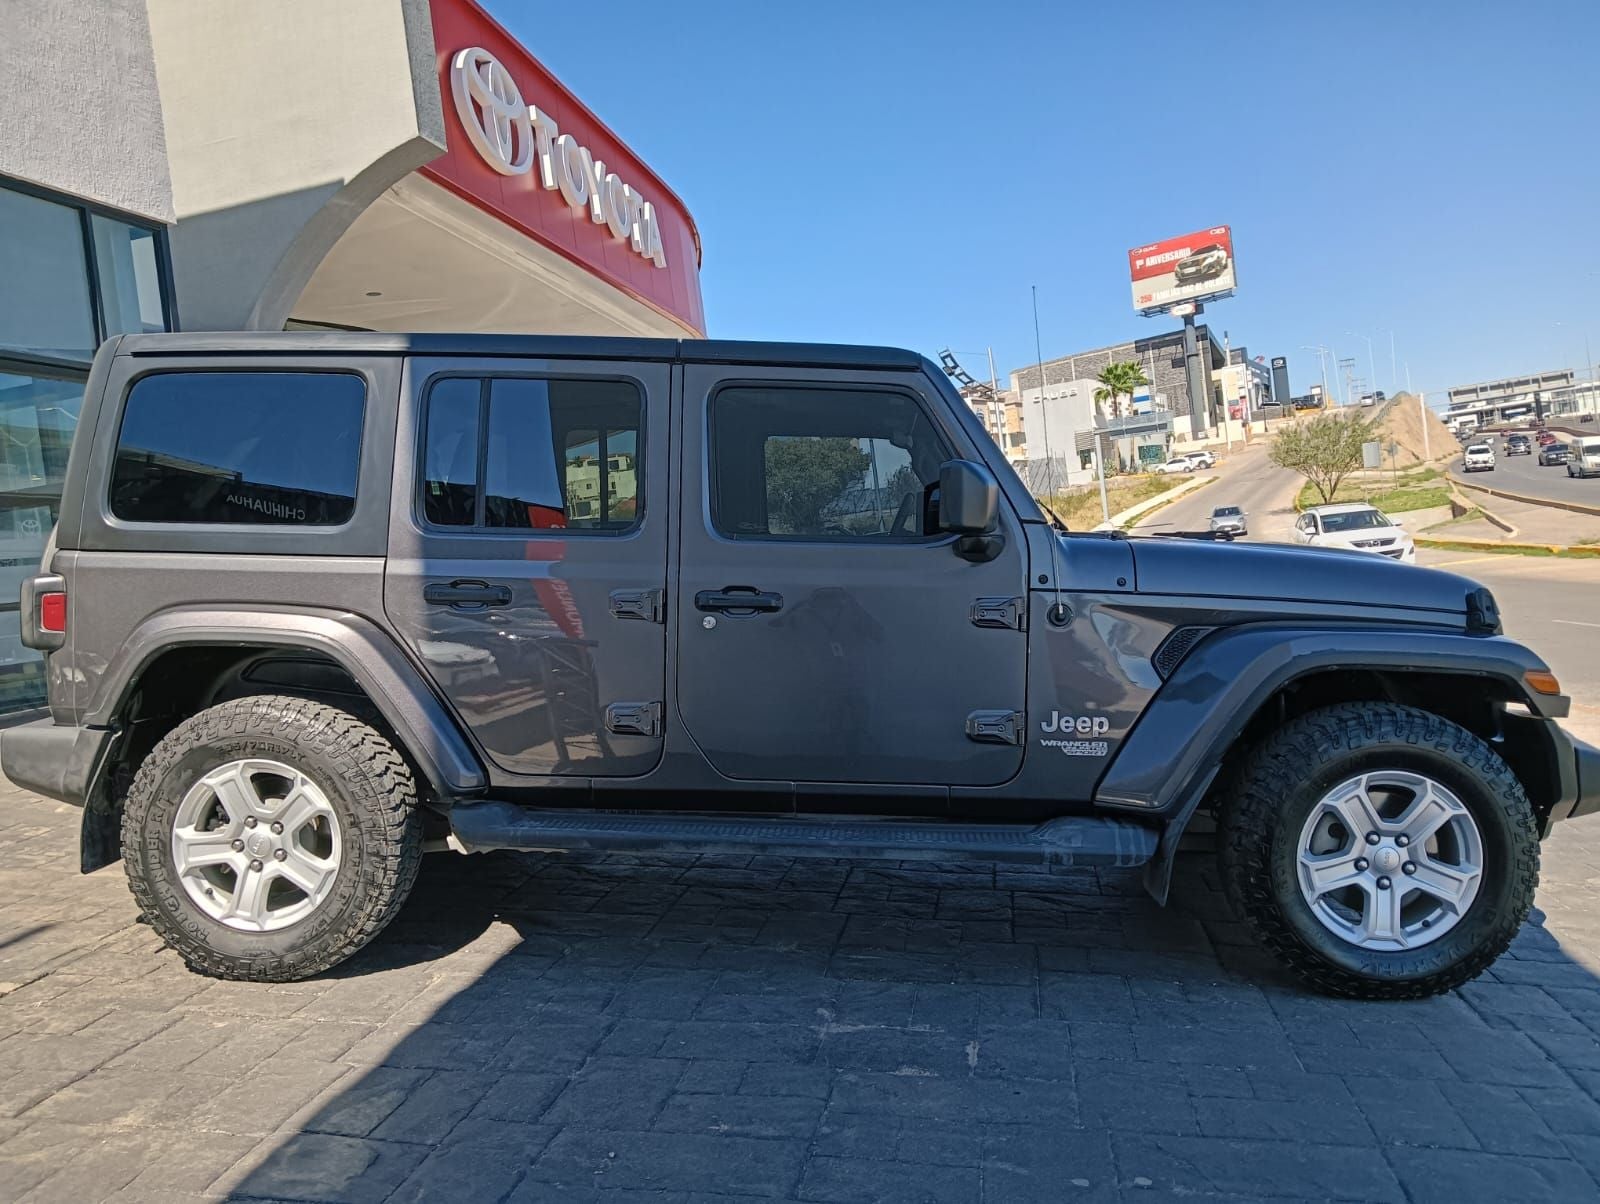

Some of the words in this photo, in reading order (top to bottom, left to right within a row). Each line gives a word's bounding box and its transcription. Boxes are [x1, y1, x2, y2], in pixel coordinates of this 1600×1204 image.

[529, 105, 667, 268] TOYOTA
[1040, 711, 1109, 737] Jeep
[1040, 739, 1108, 747] WRANGLER
